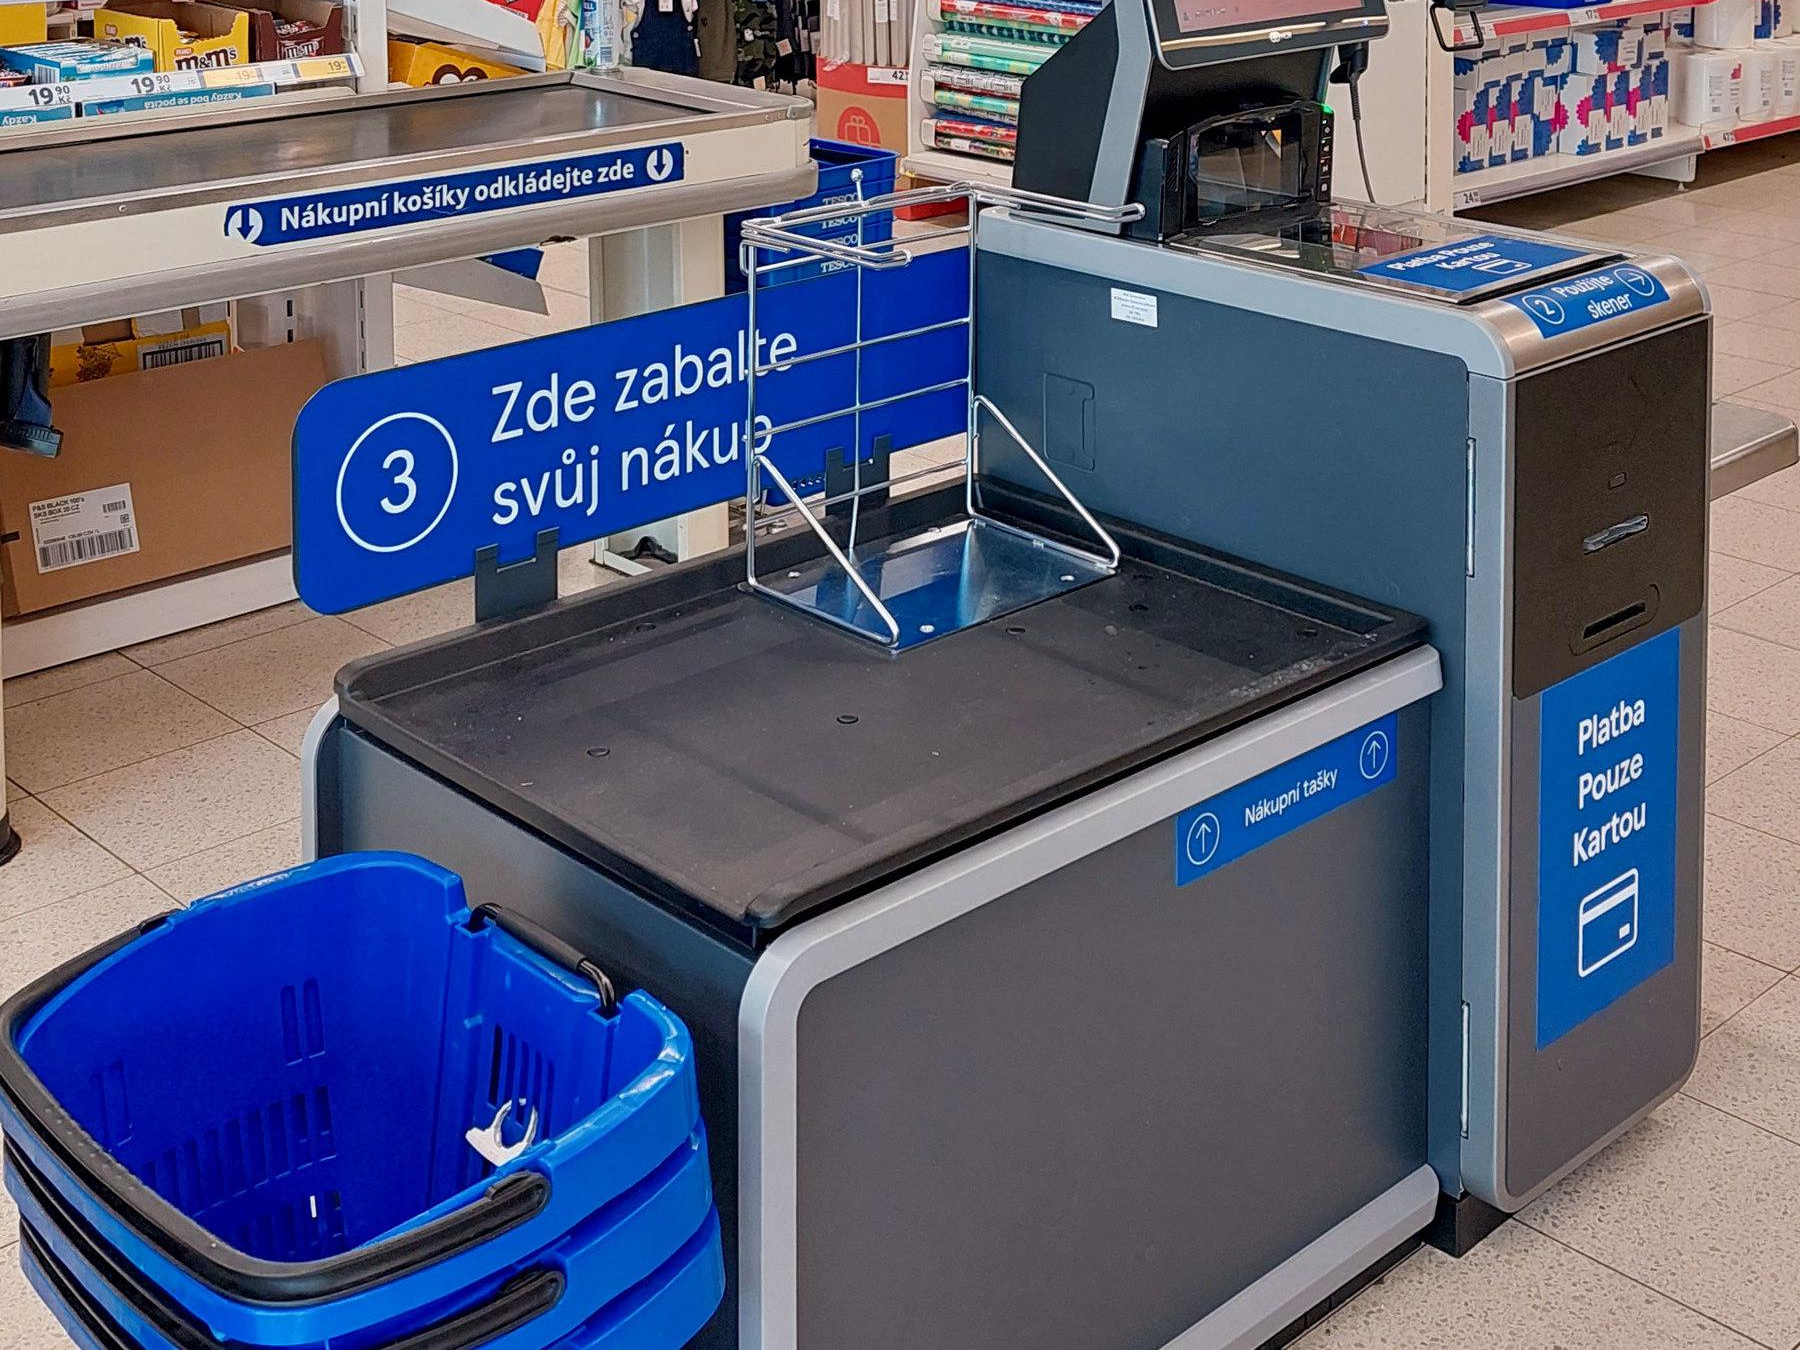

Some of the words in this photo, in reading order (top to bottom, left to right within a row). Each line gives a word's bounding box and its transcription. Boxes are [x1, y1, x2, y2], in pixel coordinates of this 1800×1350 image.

[27, 87, 54, 105] 19
[54, 85, 70, 94] 90
[130, 76, 155, 94] 19
[156, 74, 171, 84] 90
[281, 191, 389, 231] Nákupní
[393, 183, 470, 215] košíky
[474, 166, 594, 201] odkládejte
[597, 158, 635, 183] zde
[1534, 299, 1556, 316] 2
[1551, 274, 1614, 298] Použijte
[1587, 293, 1633, 319] skener
[490, 372, 596, 444] Zde
[614, 328, 798, 413] zabalte
[380, 448, 417, 515] 3
[492, 446, 600, 526] svůj
[620, 414, 774, 492] nákup
[1578, 699, 1645, 756] Platba
[1245, 782, 1301, 827] Nákupní
[1302, 768, 1338, 797] tašky
[1578, 753, 1643, 810] Pouze
[1573, 802, 1647, 867] Kartou
